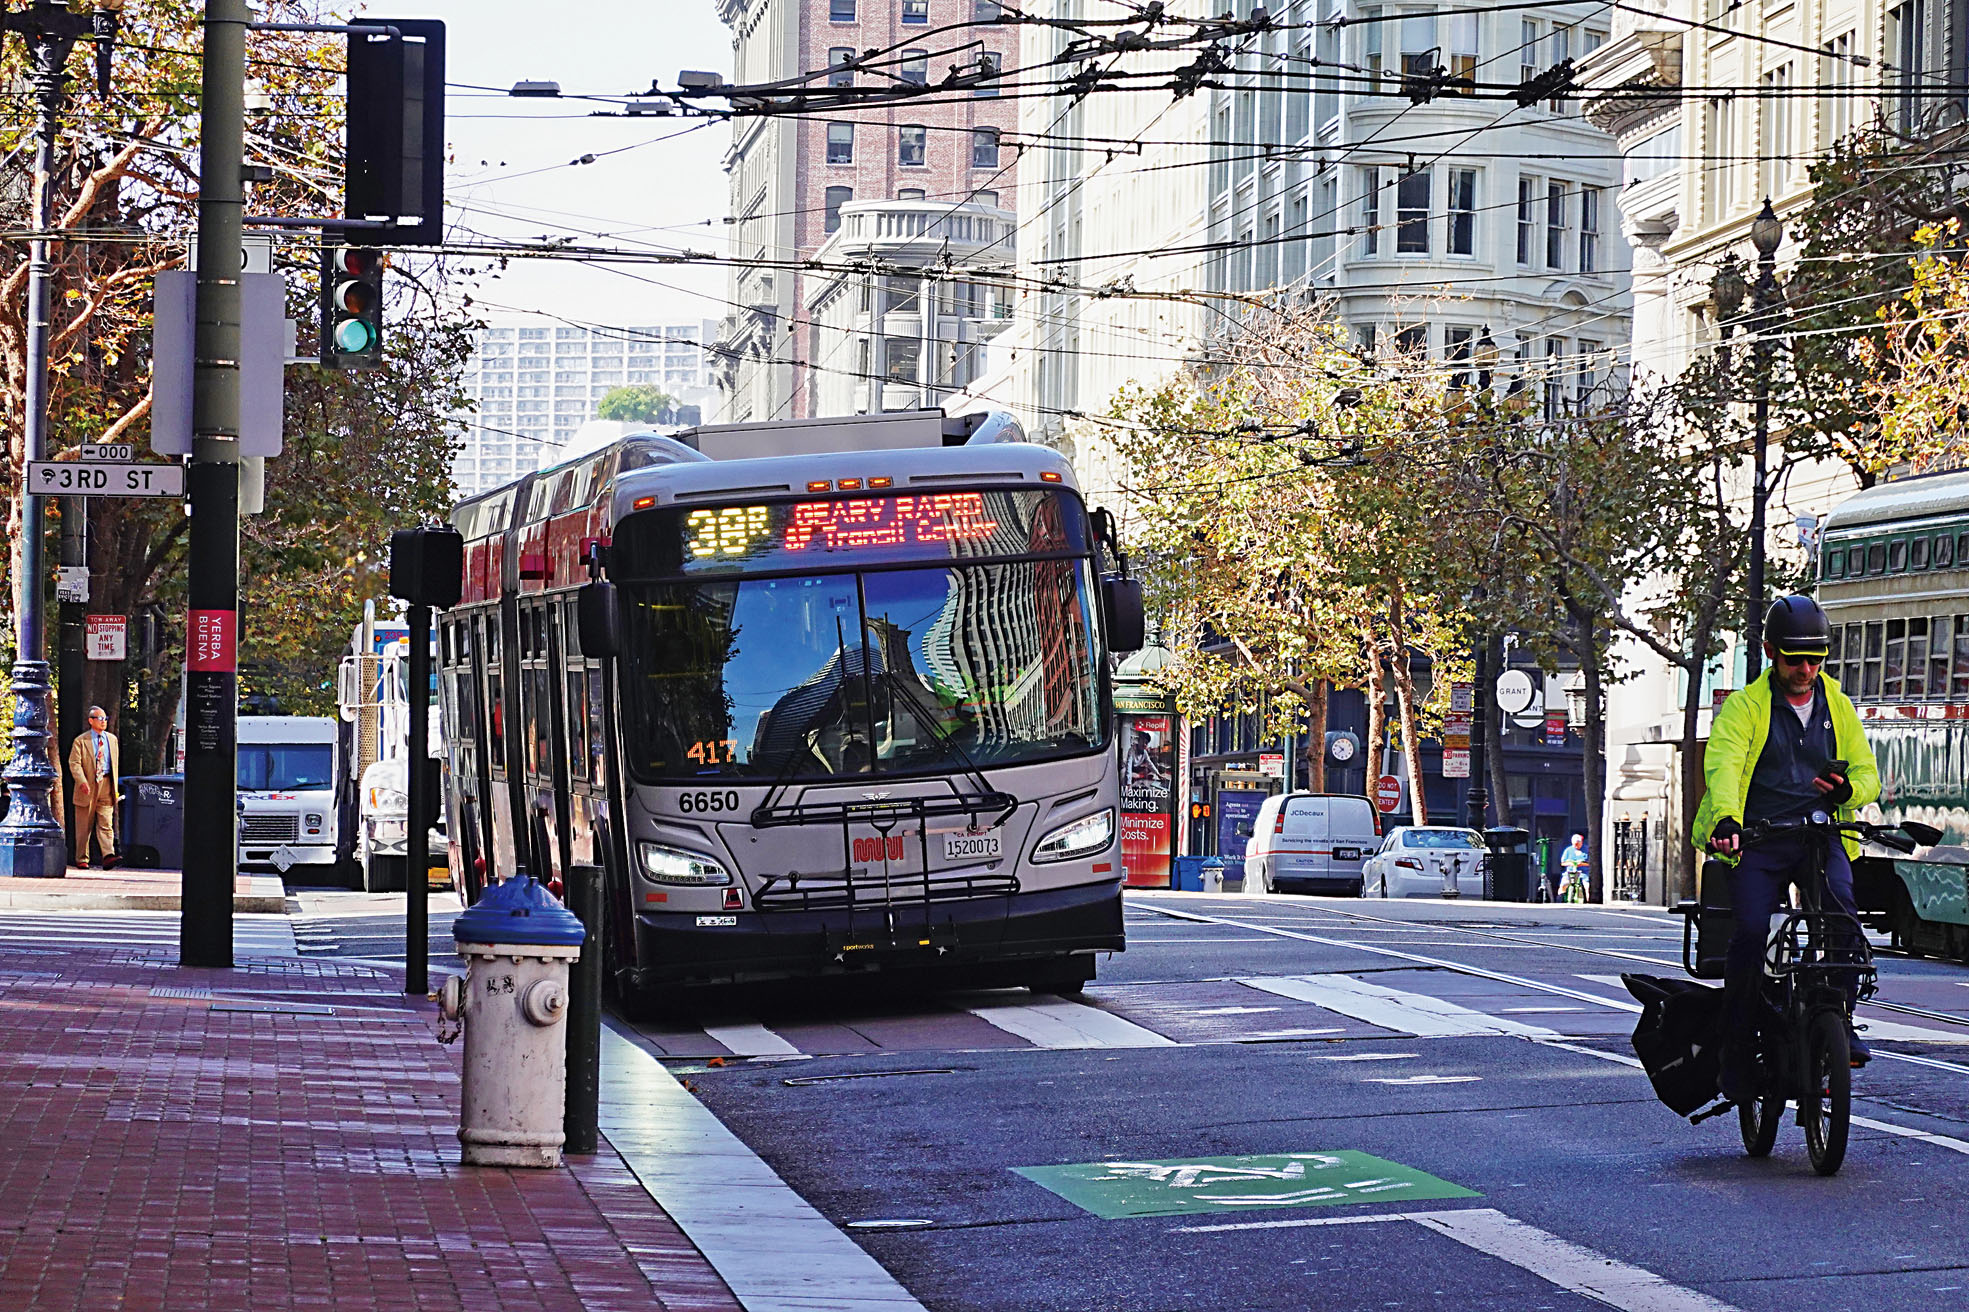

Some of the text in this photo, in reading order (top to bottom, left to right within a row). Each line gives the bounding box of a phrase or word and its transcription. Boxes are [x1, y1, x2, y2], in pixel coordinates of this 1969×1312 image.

[99, 446, 128, 458] 000
[60, 469, 153, 489] 3RD ST
[796, 493, 981, 525] GEARY RAPID
[688, 506, 770, 556] 38R
[823, 521, 905, 547] Transit
[88, 623, 124, 634] NO STOPPING
[98, 634, 114, 642] ANY
[198, 616, 208, 661] BUENA
[211, 616, 222, 660] YERBA
[1126, 701, 1166, 709] FRANCISCO
[688, 740, 738, 764] 417
[1121, 786, 1168, 798] Maximize
[679, 790, 739, 813] 6650
[1121, 798, 1158, 812] Making.
[1120, 816, 1164, 829] Minimize
[1120, 828, 1149, 840] Costs.
[948, 838, 998, 855] 1520073
